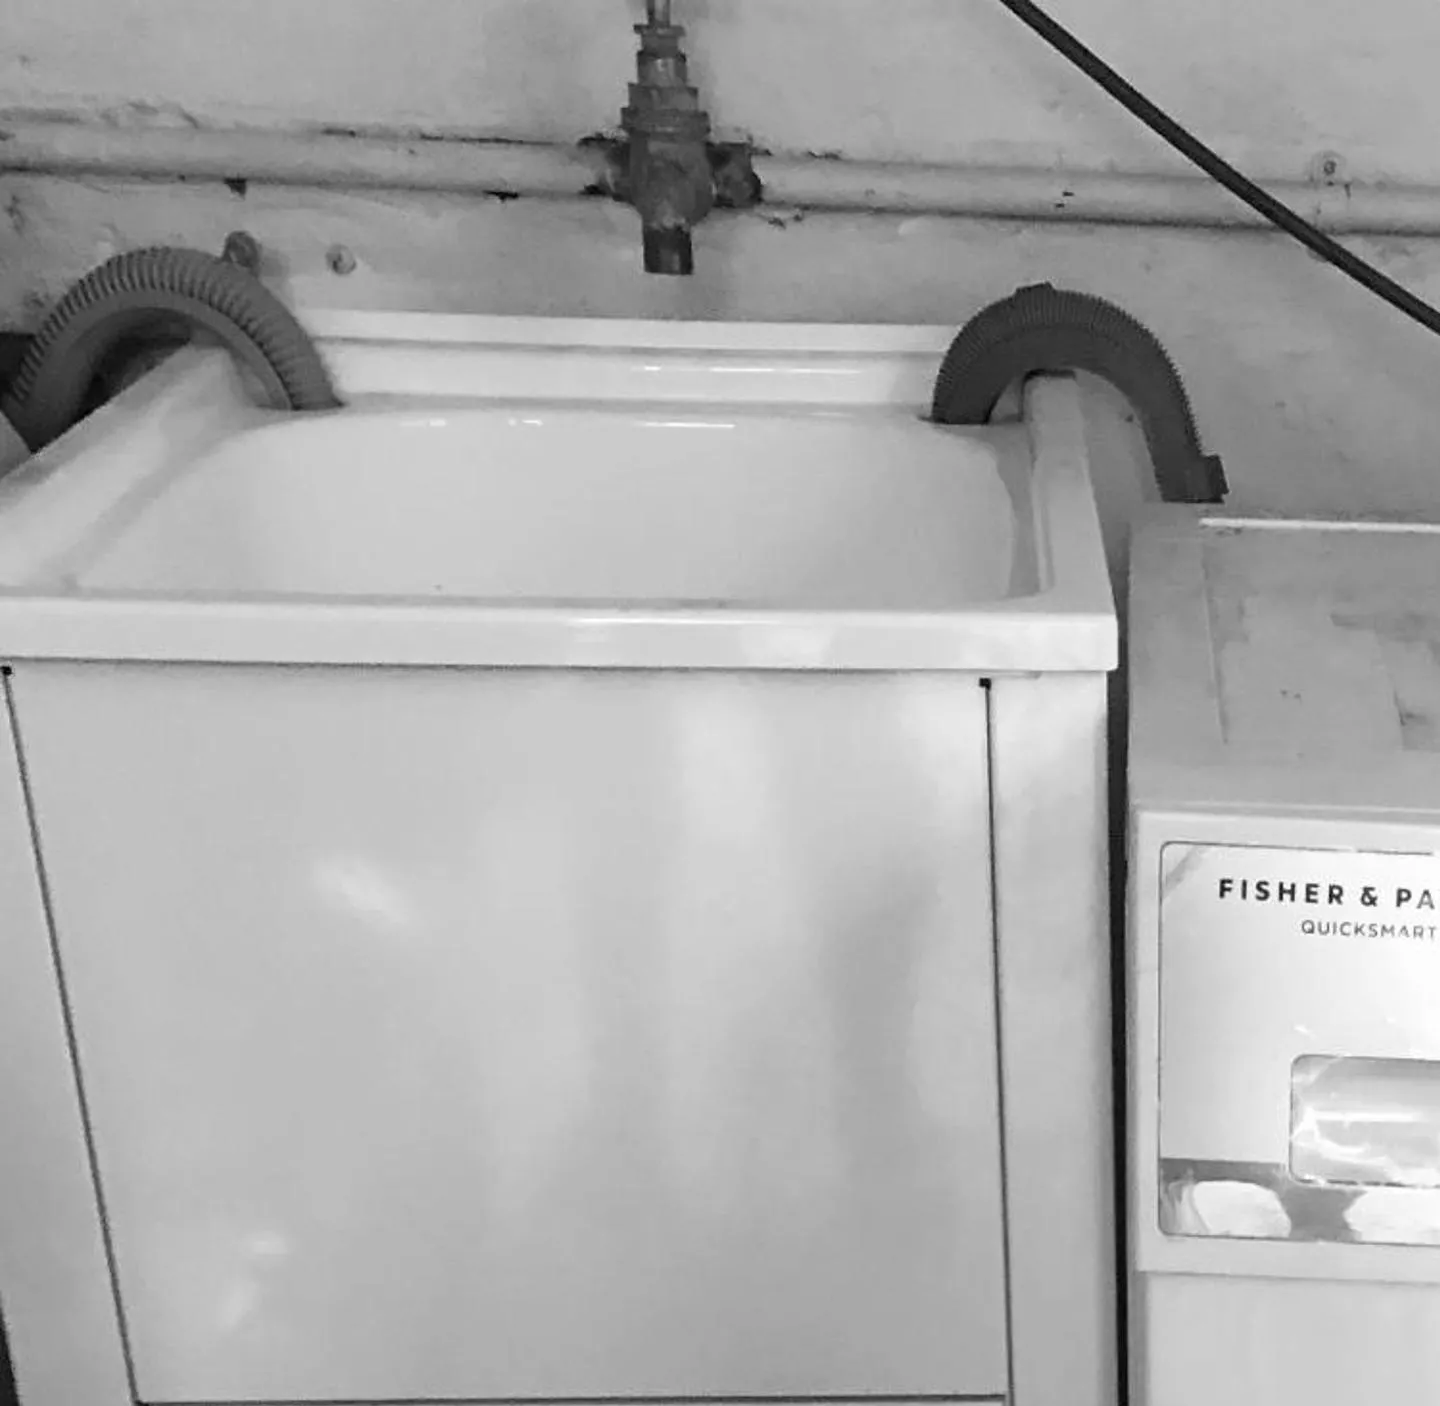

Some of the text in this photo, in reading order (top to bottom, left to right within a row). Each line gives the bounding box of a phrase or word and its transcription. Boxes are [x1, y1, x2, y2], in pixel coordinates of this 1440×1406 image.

[1218, 878, 1344, 905] FISHER
[1360, 886, 1378, 907] &
[1301, 918, 1437, 940] QUICKSMART
